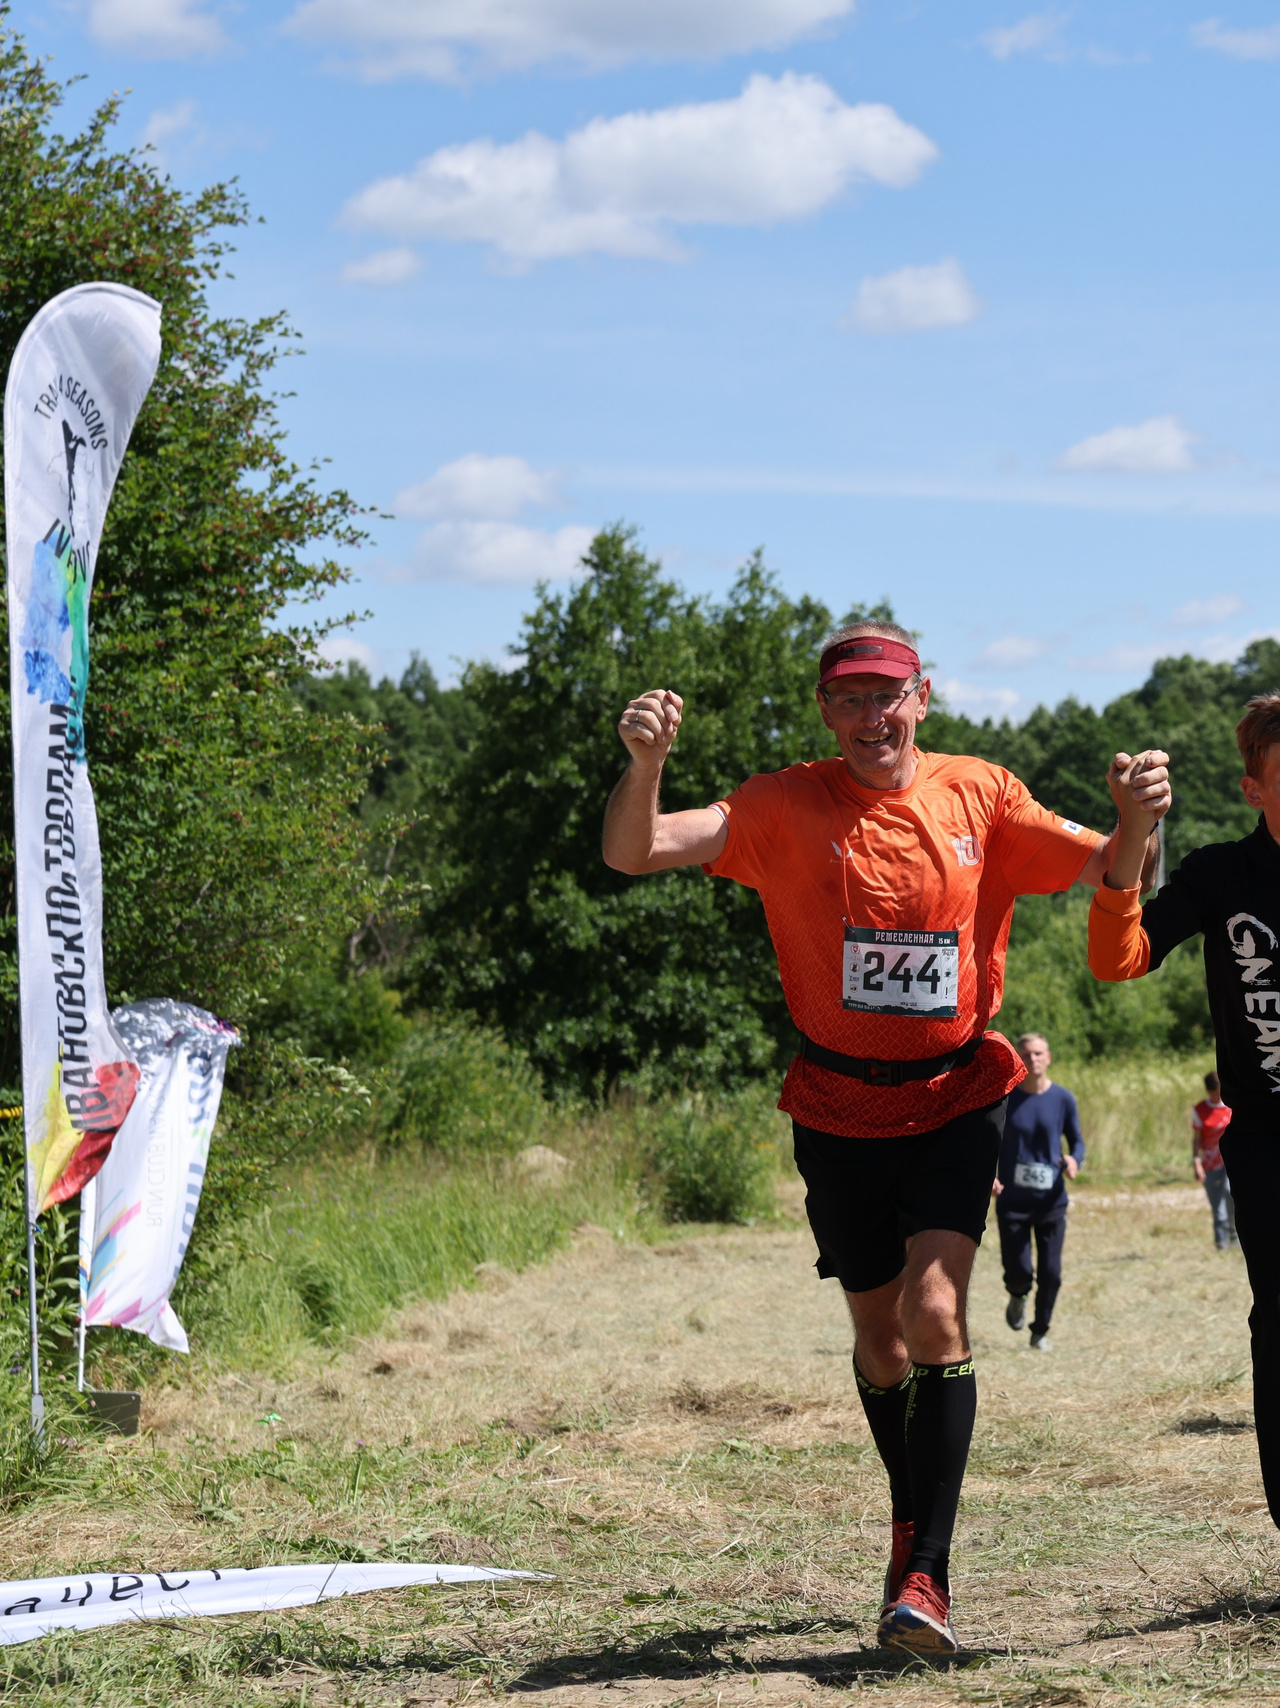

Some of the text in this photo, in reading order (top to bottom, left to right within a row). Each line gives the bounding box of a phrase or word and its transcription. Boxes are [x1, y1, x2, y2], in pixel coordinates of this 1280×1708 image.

[33, 373, 109, 450] TRA SEASONS
[875, 931, 935, 944] РЕМЕСЛЕННАЯ
[863, 951, 941, 994] 244
[1022, 1167, 1046, 1184] 245
